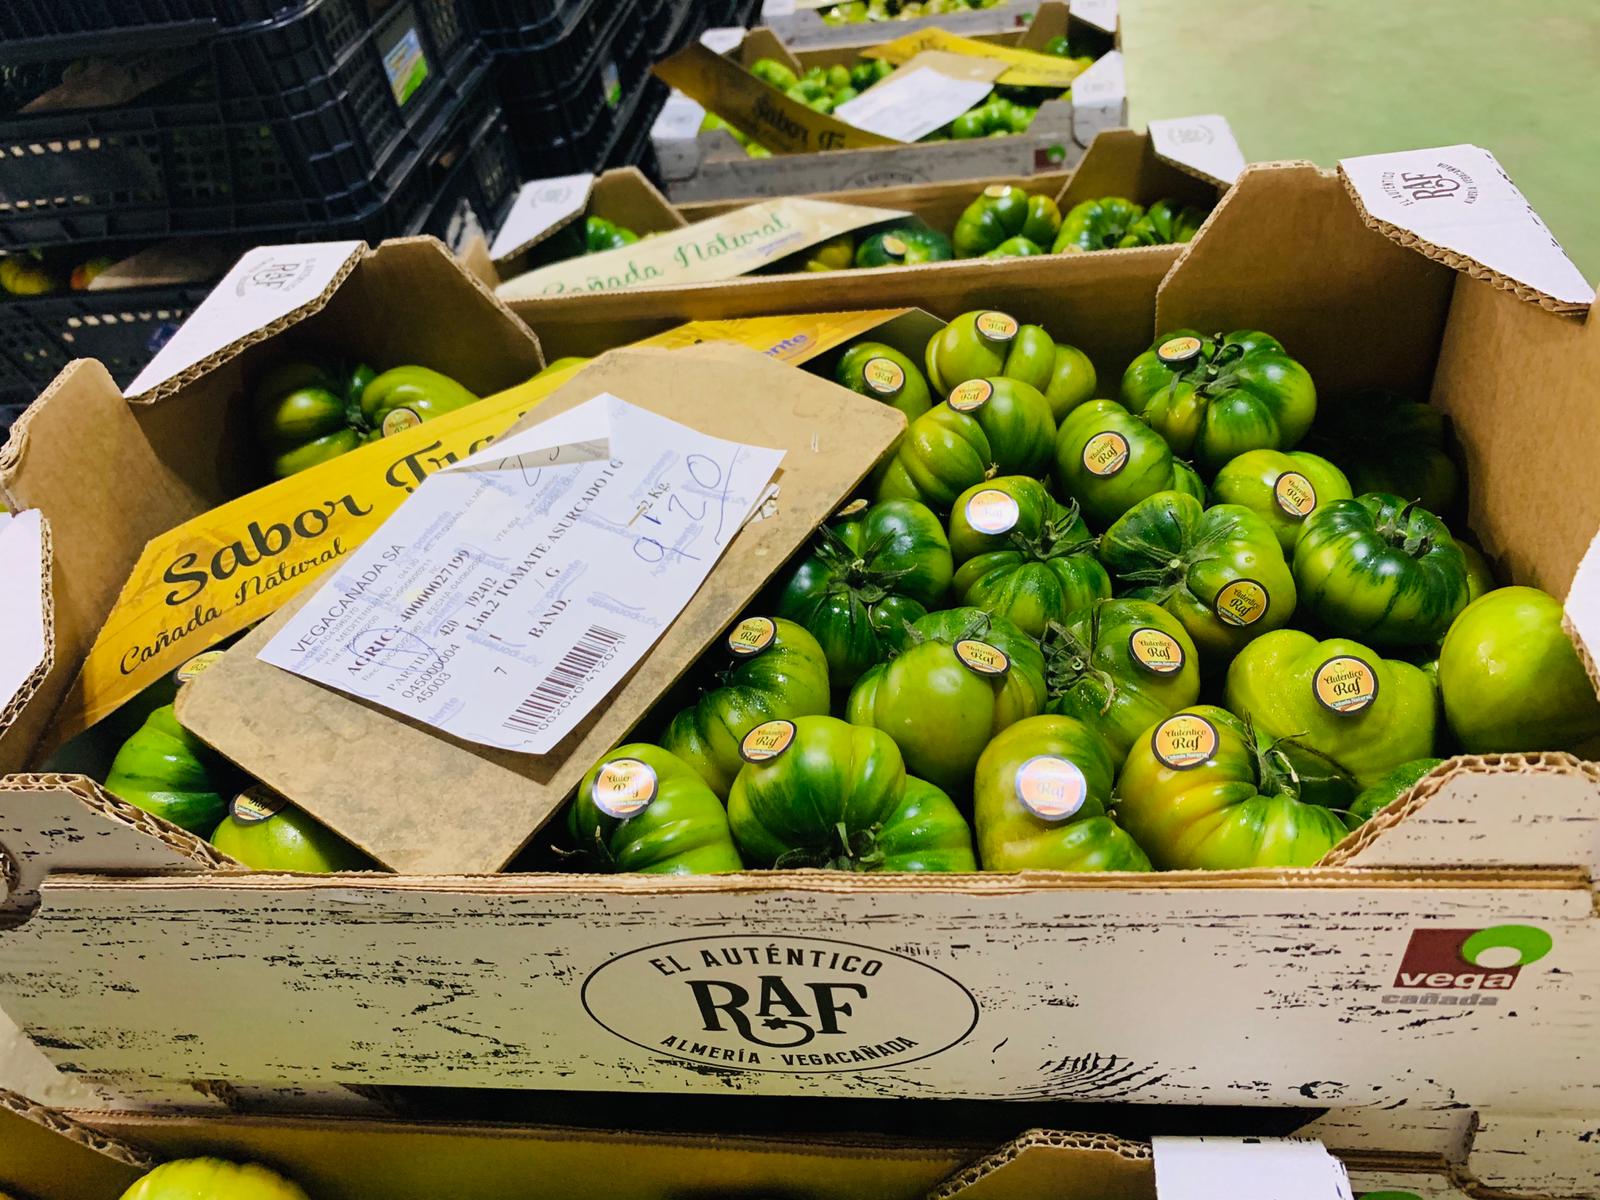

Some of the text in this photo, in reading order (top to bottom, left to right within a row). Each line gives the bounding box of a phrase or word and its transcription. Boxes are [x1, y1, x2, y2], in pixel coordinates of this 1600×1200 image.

[1401, 172, 1461, 201] RAF
[674, 212, 793, 268] Natural
[1098, 445, 1117, 464] Raf
[1287, 487, 1306, 507] Raf
[163, 493, 374, 606] Sabor
[381, 545, 405, 561] SA
[465, 598, 500, 632] Lin.2
[493, 542, 551, 597] TOMATE
[547, 477, 605, 543] ASURCADO
[608, 457, 624, 469] G
[493, 666, 507, 674] 7
[528, 598, 571, 638] BAND.
[648, 482, 670, 499] Kg.
[544, 566, 560, 576] G
[400, 551, 469, 621] 40000027199
[120, 604, 223, 677] Cañada
[234, 537, 348, 606] Natural
[440, 618, 459, 637] 420
[464, 577, 498, 607] 192412
[1229, 598, 1255, 616] Raf
[741, 632, 762, 644] Raf
[1147, 647, 1170, 660] Raf
[416, 671, 452, 703] 45003
[1333, 677, 1361, 696] Raf
[756, 735, 782, 748] Raf
[1172, 735, 1202, 751] Raf
[650, 943, 884, 978] EL AUTÉNTICO
[1400, 972, 1514, 990] vega
[1381, 992, 1499, 1006] cañada
[685, 975, 868, 1048] RAF
[659, 1035, 919, 1066] ALMERÍA VEGACAÑADA
